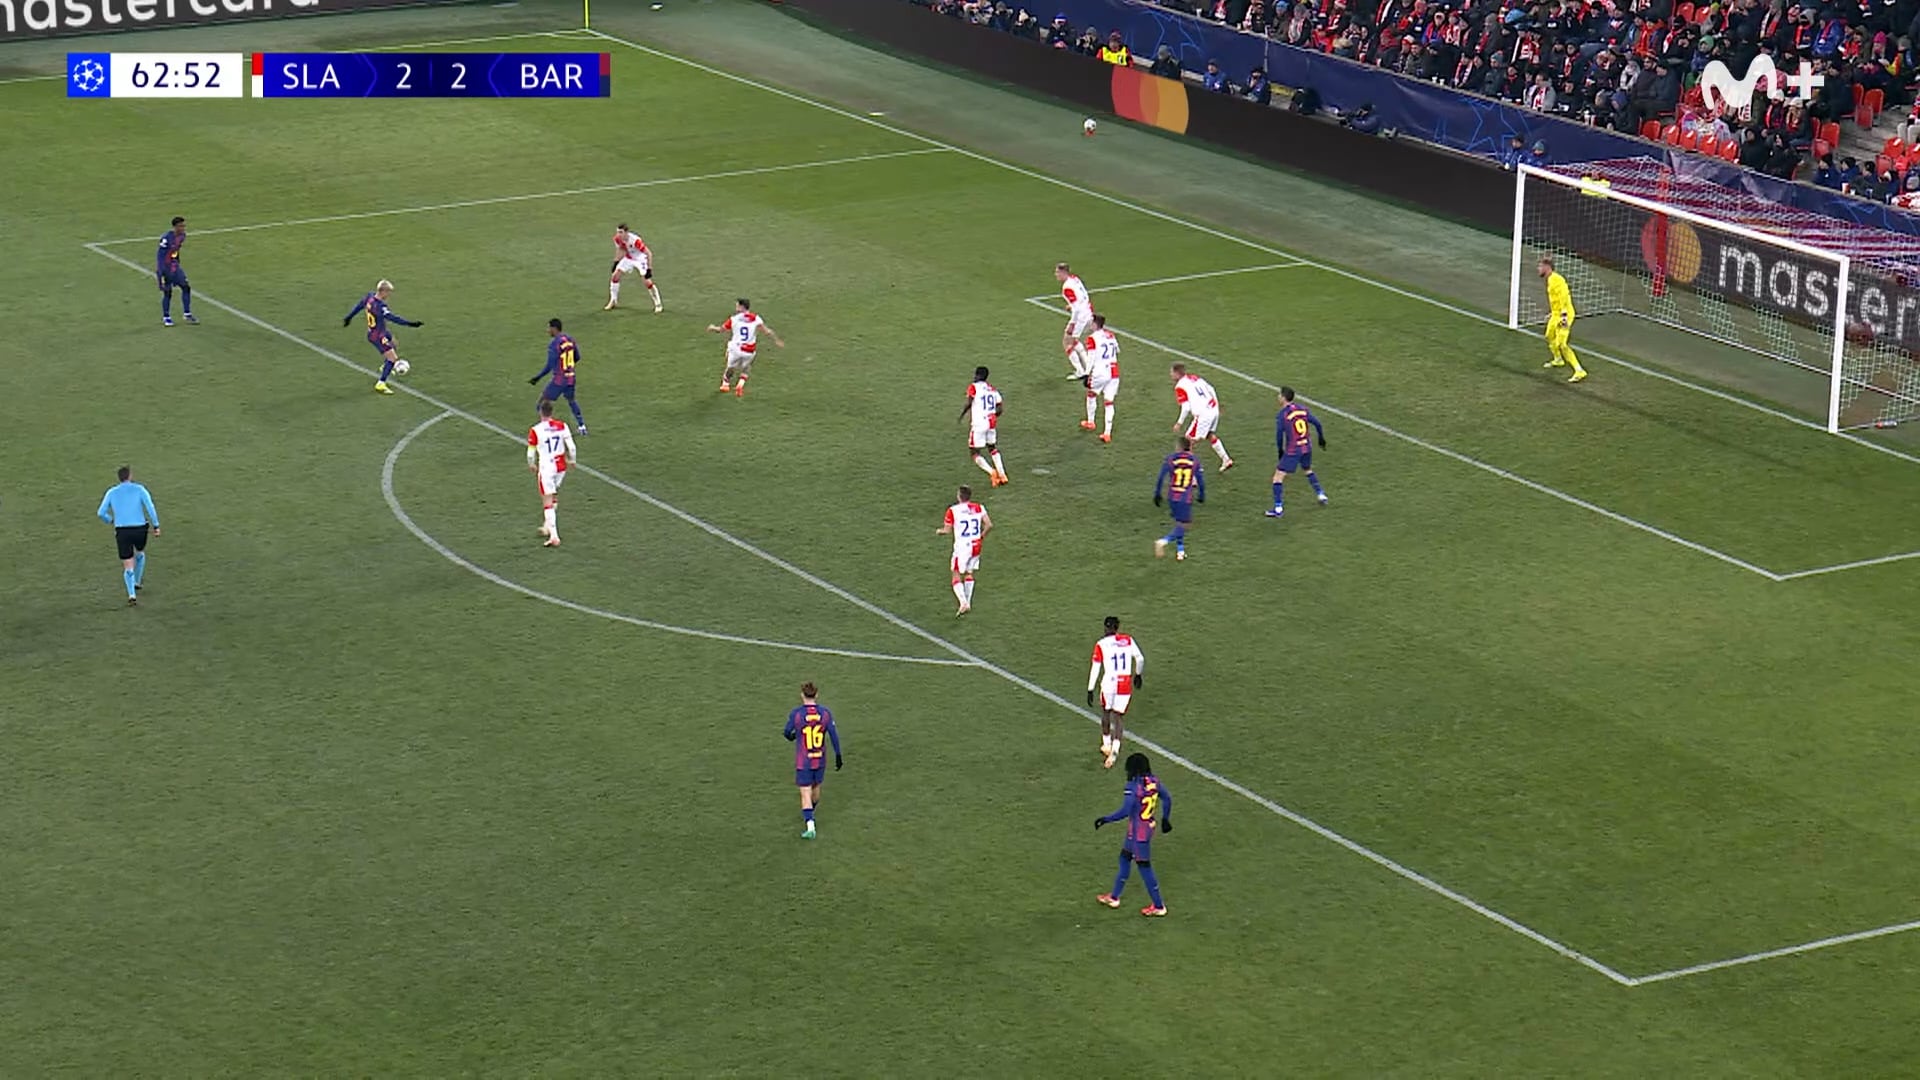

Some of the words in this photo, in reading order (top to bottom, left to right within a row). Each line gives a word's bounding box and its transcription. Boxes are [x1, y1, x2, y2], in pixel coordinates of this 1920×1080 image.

[740, 326, 749, 341] 9
[560, 350, 575, 370] 14
[1100, 342, 1116, 360] 27
[1194, 386, 1207, 399] 4
[981, 394, 995, 411] 19
[1295, 419, 1307, 438] 9
[544, 436, 560, 453] 17
[1174, 468, 1192, 488] 11
[960, 518, 980, 537] 23
[1111, 652, 1126, 671] 11
[802, 724, 824, 750] 16
